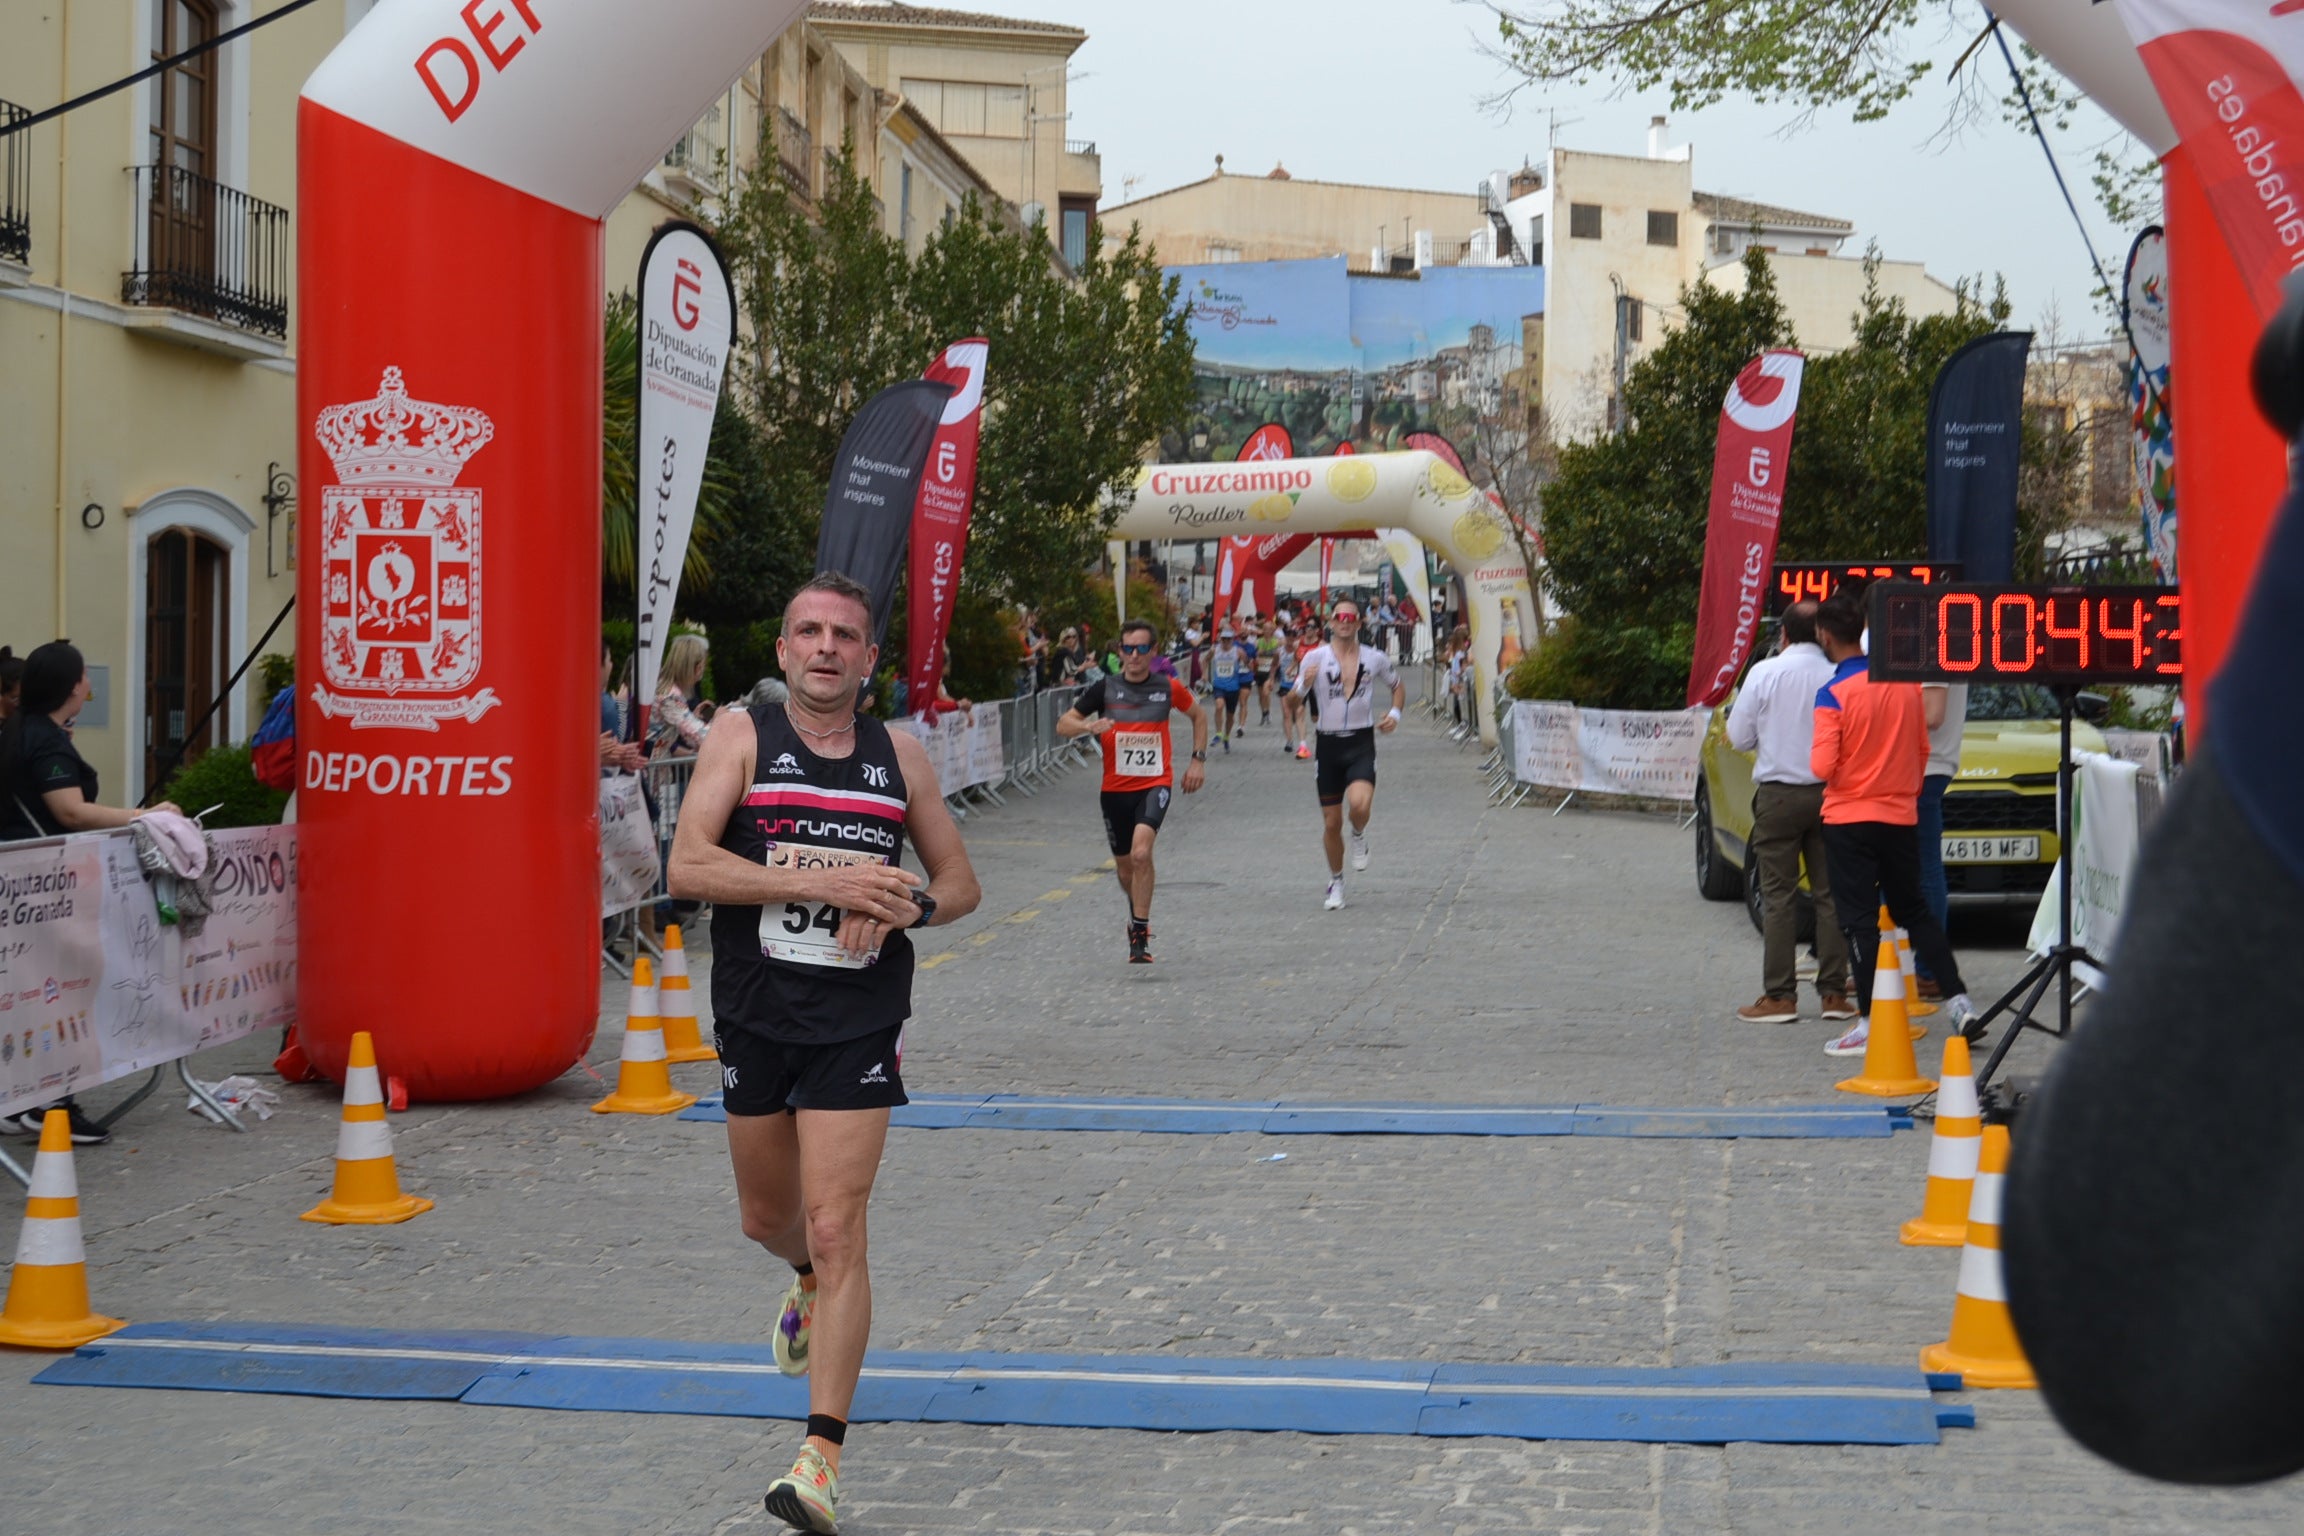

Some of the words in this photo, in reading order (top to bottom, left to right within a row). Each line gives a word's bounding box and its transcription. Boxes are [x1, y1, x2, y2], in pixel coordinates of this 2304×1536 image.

[647, 319, 717, 368] Diputación
[646, 347, 663, 371] de
[664, 353, 717, 394] Granada
[1944, 421, 2005, 435] Movement
[1945, 438, 1969, 452] that
[851, 454, 911, 479] Movement
[1944, 455, 1986, 469] inspires
[848, 471, 872, 486] that
[1151, 468, 1312, 496] Cruzcampo
[843, 486, 886, 507] inspires
[923, 479, 967, 500] Diputación
[1732, 481, 1781, 505] Diputación
[931, 495, 965, 513] Granad
[1168, 502, 1247, 528] Radler
[360, 711, 425, 723] GRANADA
[1123, 749, 1156, 766] 732
[305, 750, 514, 796] DEPORTES
[756, 818, 895, 848] runrundato
[800, 849, 826, 860] GRAN
[828, 853, 861, 865] PREMIO
[1945, 841, 1992, 858] 4618
[1998, 839, 2034, 858] MFJ
[210, 851, 287, 898] ONDO
[14, 894, 73, 925] Granada
